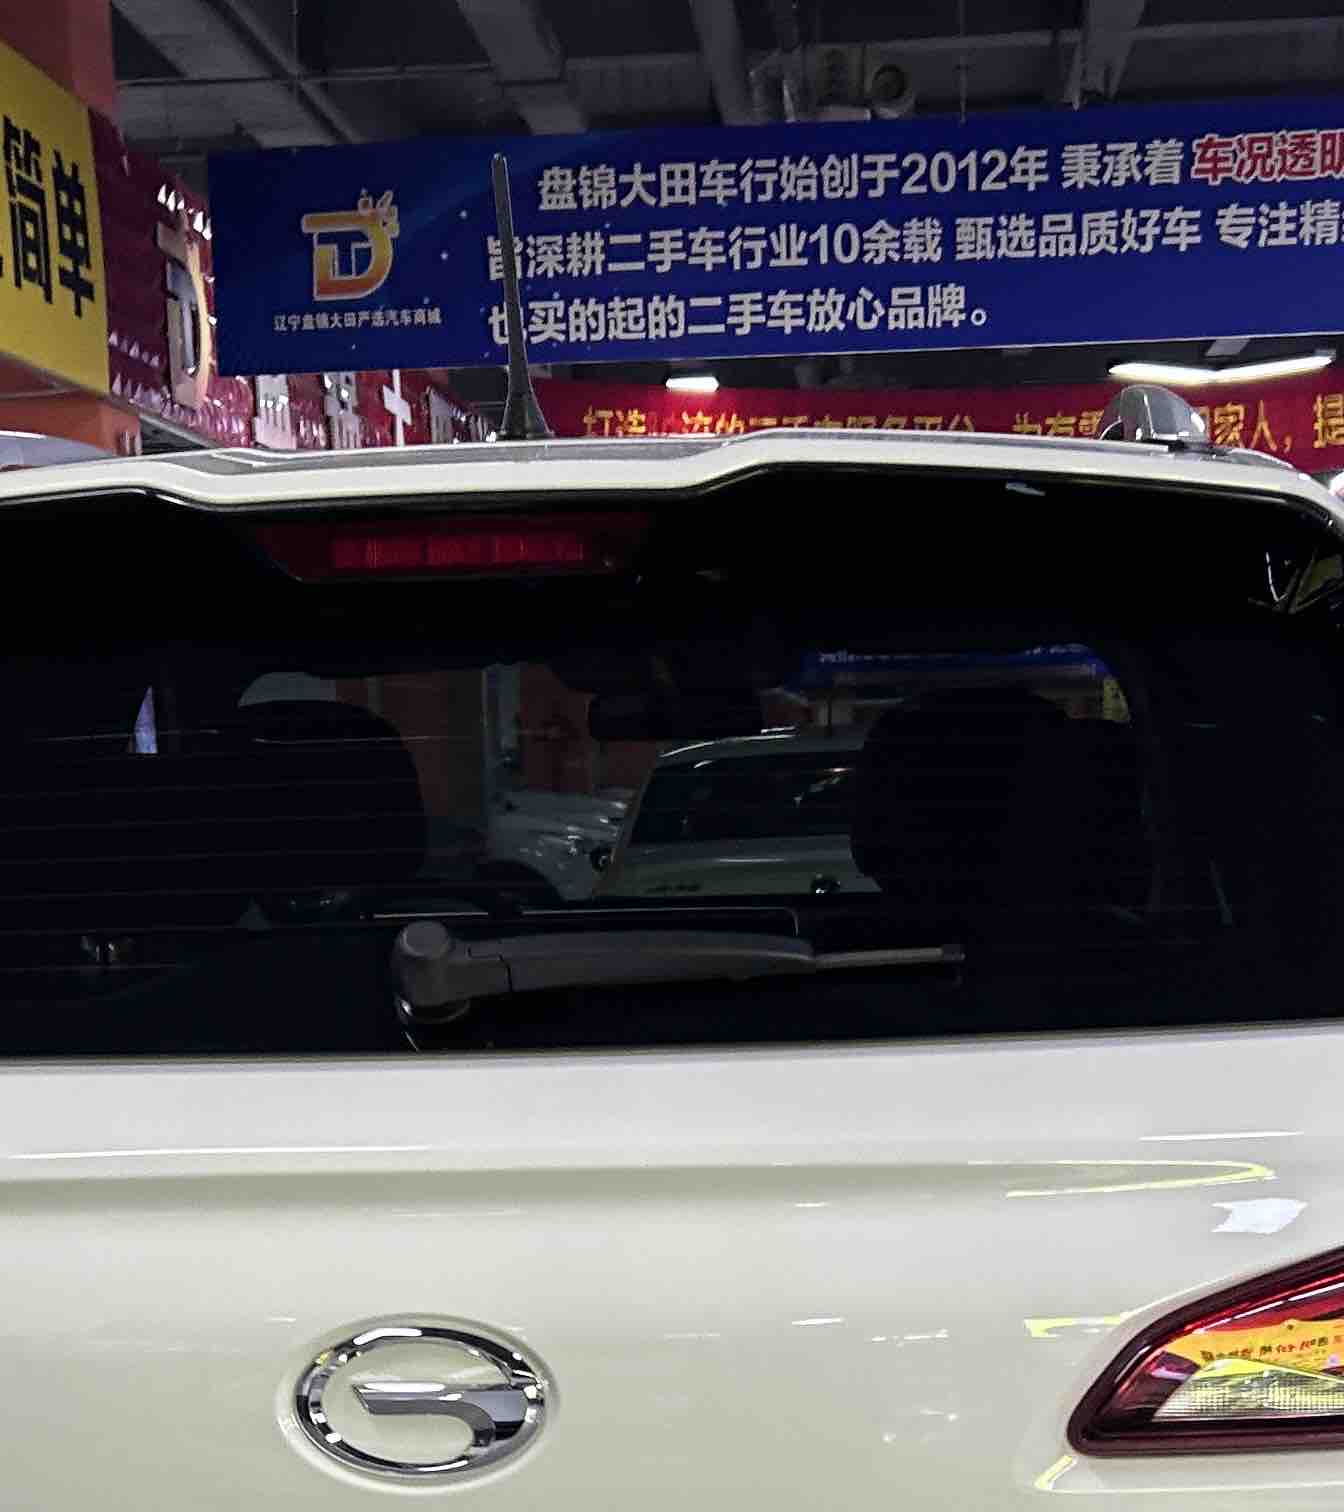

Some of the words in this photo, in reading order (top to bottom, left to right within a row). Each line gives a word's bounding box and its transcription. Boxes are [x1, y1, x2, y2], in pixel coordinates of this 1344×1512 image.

[538, 146, 1049, 211] 盘锦大田车行始创于2012年
[1060, 139, 1185, 192] 秉承着
[955, 205, 1202, 263] 甄选品质好车
